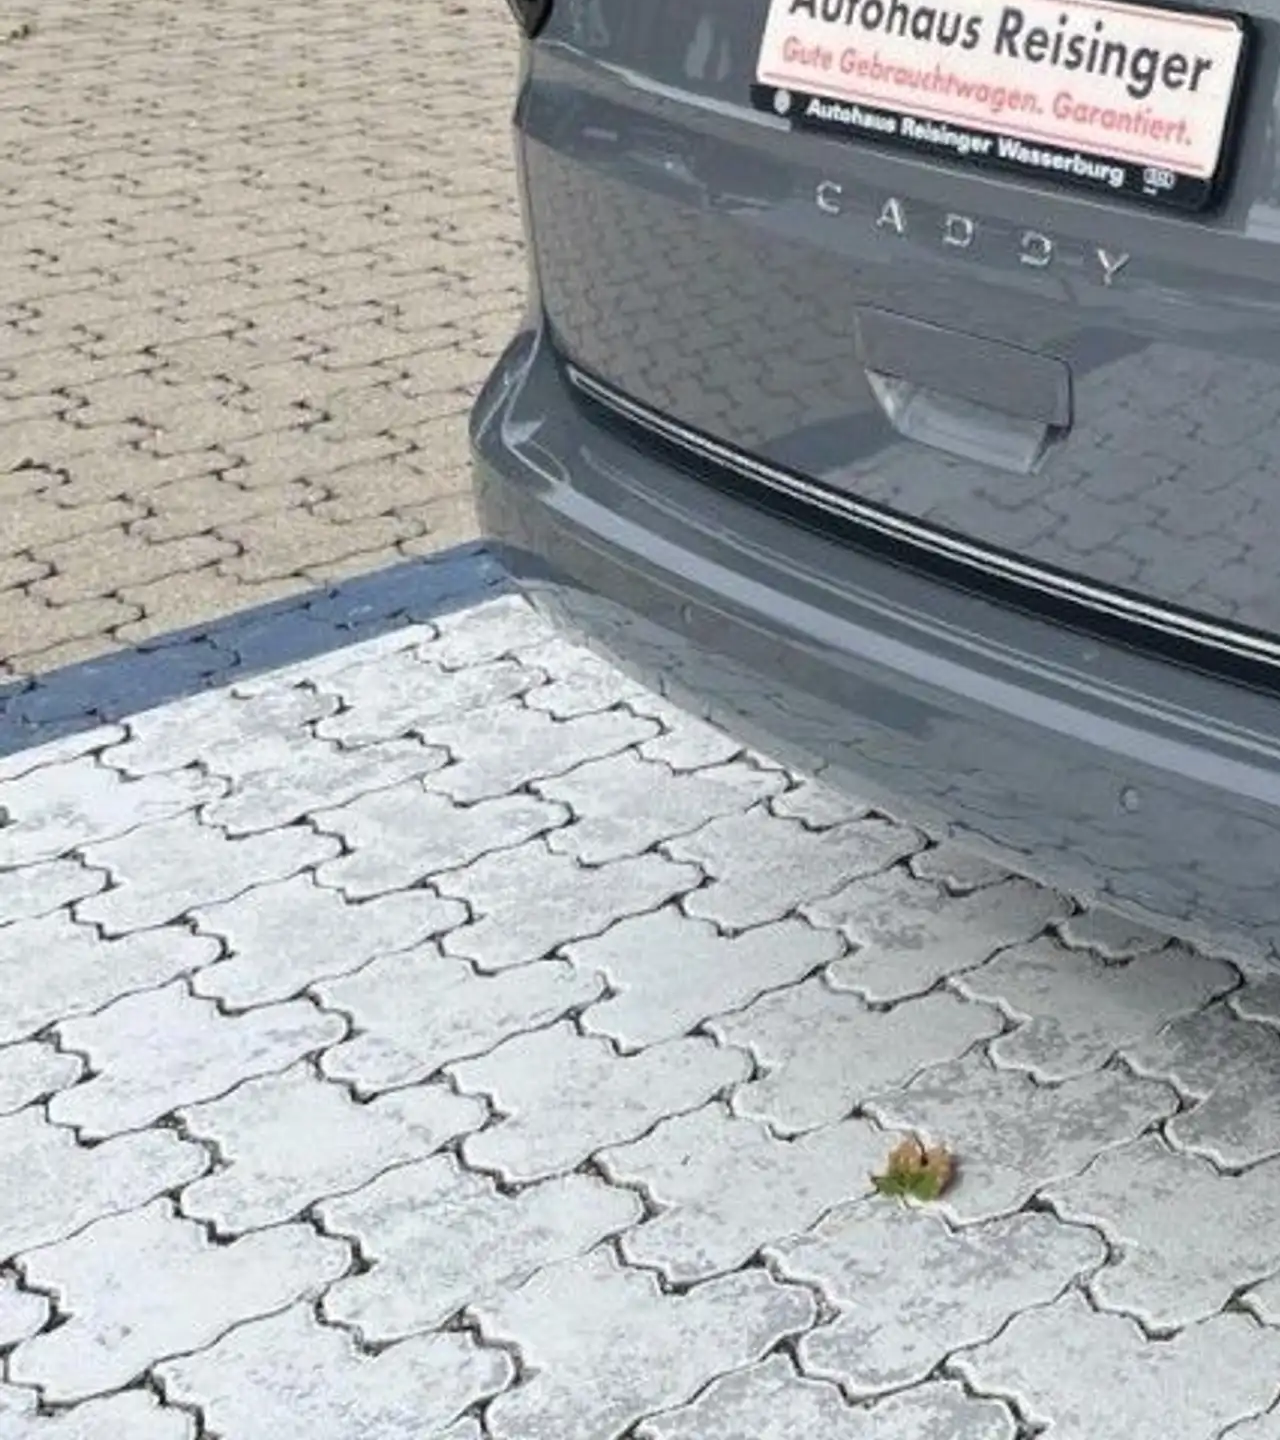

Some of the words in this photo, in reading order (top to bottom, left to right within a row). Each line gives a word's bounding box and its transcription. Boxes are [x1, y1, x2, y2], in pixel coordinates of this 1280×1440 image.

[782, 35, 833, 70] Gute
[840, 46, 1044, 115] Gebrauchtwagen.
[1053, 91, 1193, 146] Garantiert.
[994, 6, 1213, 99] Reisinger
[805, 98, 898, 133] Autohaus
[901, 116, 994, 155] Reisinger
[997, 132, 1125, 188] Wasserburg
[815, 179, 1130, 286] CADDY
